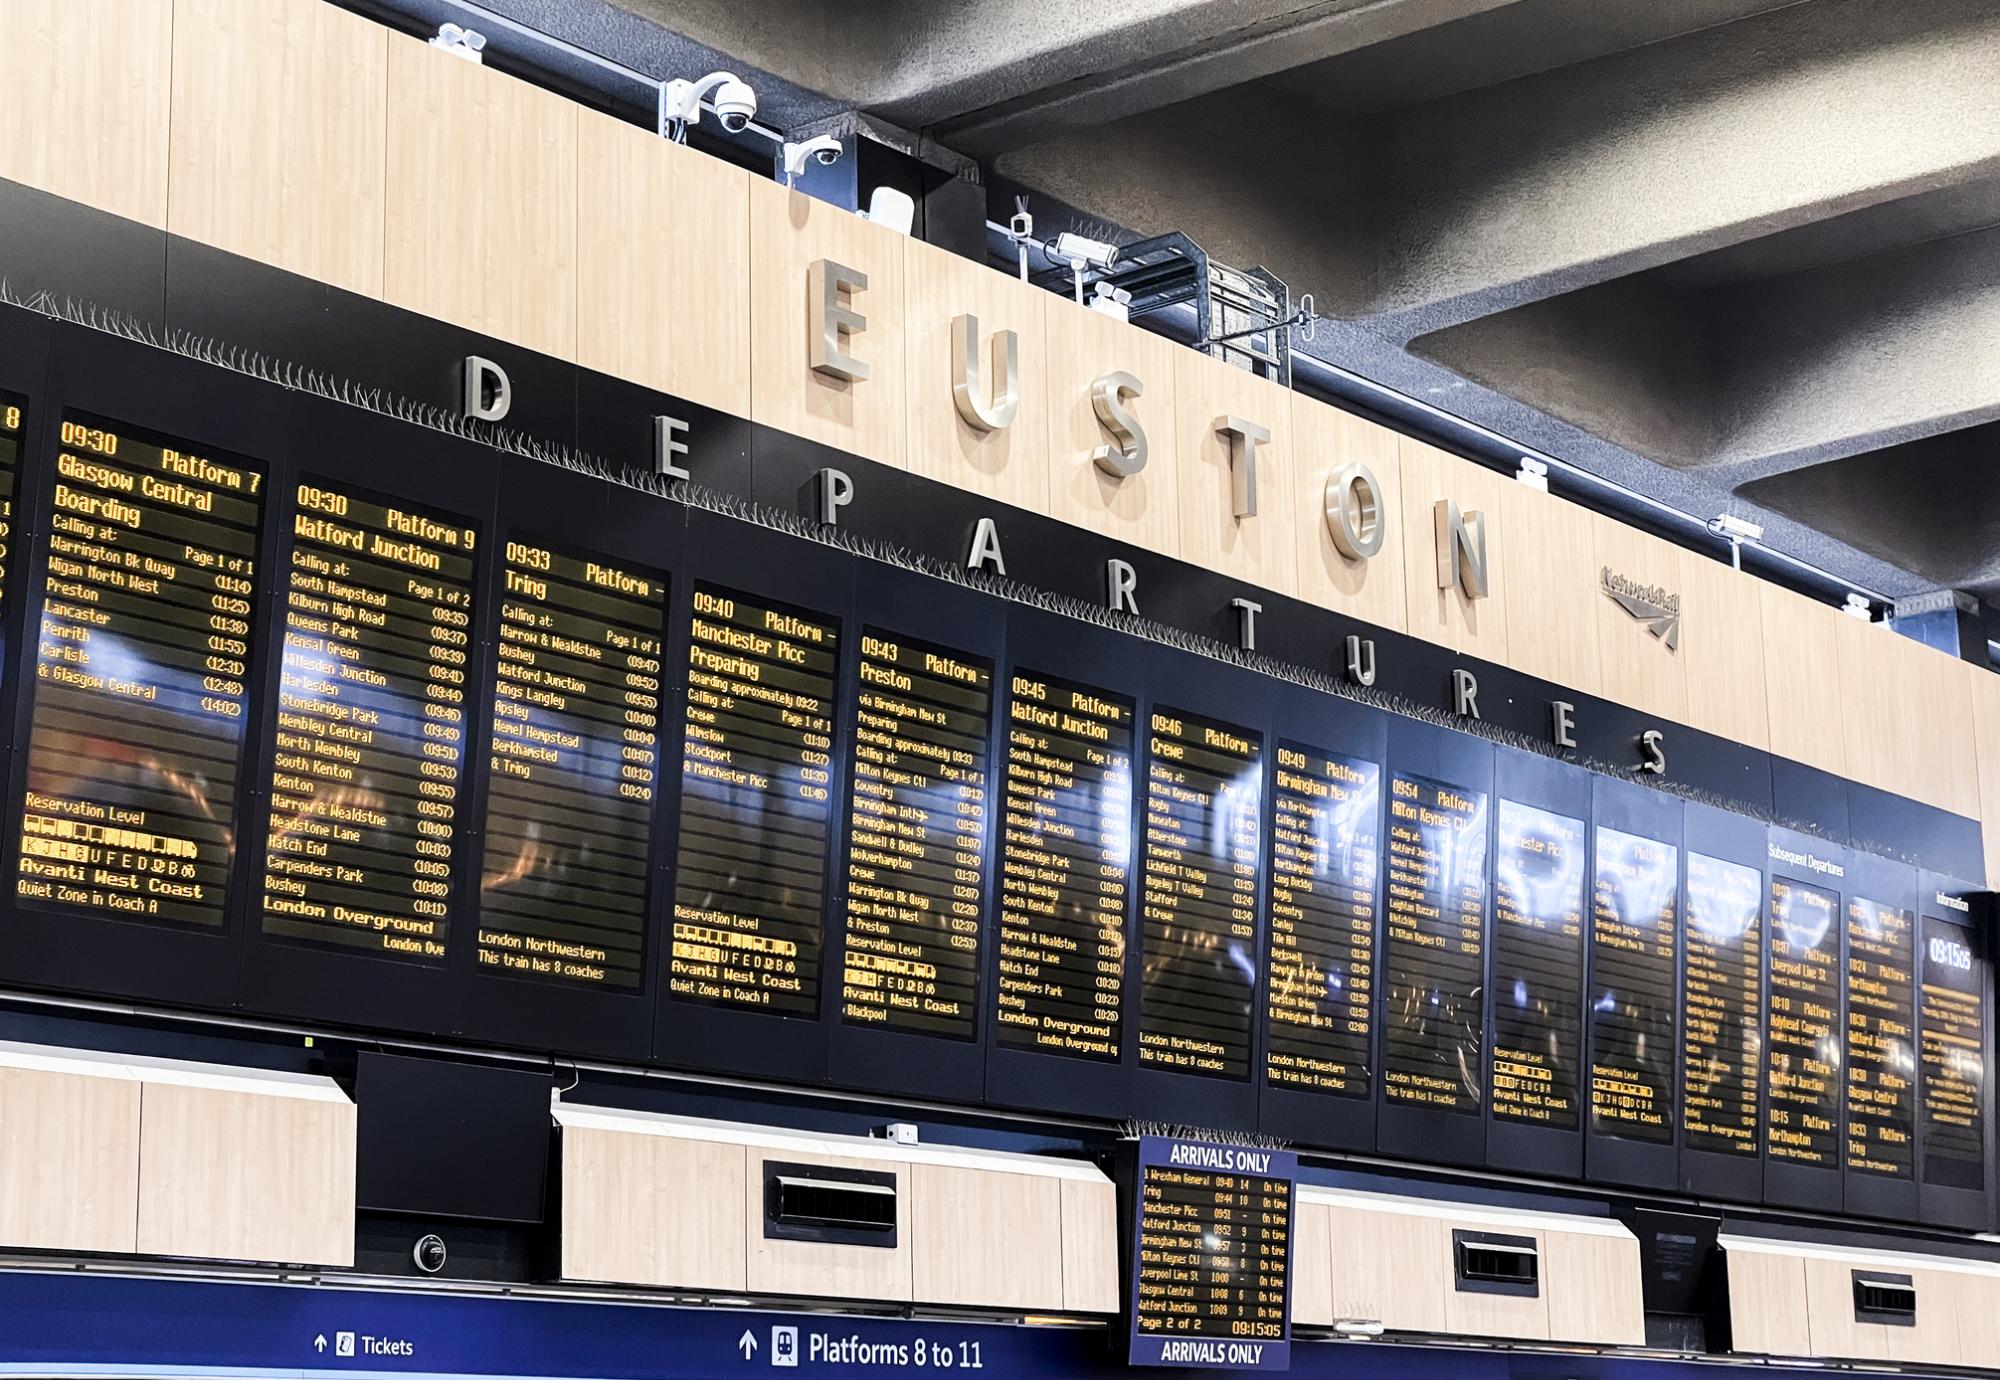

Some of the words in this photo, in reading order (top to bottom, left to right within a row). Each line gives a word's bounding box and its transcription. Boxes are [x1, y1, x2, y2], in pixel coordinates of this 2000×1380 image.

[7, 406, 20, 429] 8
[808, 257, 1489, 601] EUSTON
[61, 422, 117, 455] 09:30
[162, 448, 240, 488] Platform
[249, 472, 261, 492] 7
[58, 454, 133, 491] Glasgow
[142, 476, 212, 511] Central
[55, 485, 140, 529] Boarding
[298, 485, 347, 516] 09:30
[388, 508, 457, 545] Platform
[464, 530, 475, 550] 9
[53, 514, 94, 539] Calling
[99, 527, 117, 541] at:
[185, 546, 214, 567] Page
[218, 555, 224, 567] 1
[228, 557, 242, 571] of
[248, 562, 253, 575] 1
[295, 514, 364, 550] Watford
[371, 535, 440, 570] Junction
[48, 556, 82, 577] Wigan
[88, 565, 124, 586] North
[129, 576, 159, 594] West
[51, 535, 120, 564] Warrington
[126, 553, 140, 568] Bk
[145, 558, 175, 579] Quay
[215, 575, 251, 595] (11:14)
[292, 551, 329, 575] Calling
[334, 563, 350, 576] at:
[408, 580, 433, 598] Page
[437, 588, 442, 600] 1
[447, 590, 460, 604] of
[463, 594, 470, 607] 2
[464, 354, 1669, 776] DEPARTURES
[506, 542, 550, 570] 09:33
[586, 563, 649, 596] Platform
[46, 577, 98, 601] Preston
[290, 573, 323, 592] South
[328, 581, 386, 607] Hampstead
[505, 569, 547, 601] Tring
[45, 598, 110, 625] Lancaster
[289, 591, 328, 613] Kilburn
[332, 601, 355, 620] High
[359, 609, 385, 627] Road
[502, 604, 535, 625] Calling
[540, 615, 553, 627] at:
[694, 592, 734, 619] 09:40
[766, 611, 822, 642] Platform
[43, 621, 90, 642] Penrith
[287, 612, 327, 633] Queens
[332, 622, 358, 640] Park
[500, 624, 537, 643] Harrow
[541, 633, 549, 646] &
[552, 636, 601, 659] Wealdstne
[692, 618, 772, 655] Manchester
[778, 642, 805, 663] Picc
[40, 642, 90, 664] Carlisle
[499, 644, 535, 664] Bushey
[690, 646, 760, 681] Preparing
[862, 636, 897, 662] 09:43
[926, 653, 976, 683] Platform
[38, 664, 49, 677] &
[53, 666, 103, 689] Glasgow
[109, 677, 156, 699] Central
[497, 662, 540, 682] Watford
[544, 672, 586, 694] Junction
[860, 661, 911, 691] Preston
[496, 680, 523, 699] Kings
[527, 688, 565, 710] Langley
[859, 694, 872, 707] via
[874, 697, 917, 718] Birmingham
[919, 707, 935, 721] New
[937, 712, 946, 725] St
[1012, 677, 1046, 700] 09:45
[1072, 692, 1119, 719] Platform
[279, 711, 325, 737] Wembley
[329, 723, 372, 744] Central
[687, 706, 715, 724] Crewe
[1011, 701, 1057, 728] Watford
[1062, 715, 1108, 741] Junction
[1151, 738, 1184, 760] Crewe
[1152, 714, 1182, 736] 09:46
[1205, 728, 1248, 753] Platform
[492, 738, 558, 763] Berkhamsted
[684, 742, 732, 763] Stockport
[1278, 748, 1305, 769] 09:49
[1327, 761, 1365, 785] Platform
[1277, 770, 1328, 797] Birmingham
[1393, 779, 1418, 799] 09:54
[1438, 791, 1474, 814] Platform
[26, 792, 104, 819] Reservation
[110, 804, 144, 825] Level
[1392, 800, 1416, 819] Milton
[1768, 843, 1807, 867] Subsequent
[1808, 854, 1844, 877] Departures
[20, 857, 85, 881] Avanti
[94, 867, 140, 889] West
[149, 877, 203, 899] Coast
[18, 879, 51, 898] Quiet
[58, 885, 88, 903] Zone
[93, 888, 103, 905] in
[108, 893, 144, 912] Coach
[150, 900, 157, 914] A
[1936, 891, 1969, 912] Information
[264, 895, 325, 918] London
[333, 906, 434, 935] Overground
[478, 930, 521, 948] London
[526, 937, 606, 961] Northwestern
[478, 949, 499, 964] This
[503, 953, 529, 969] train
[532, 957, 550, 972] has
[554, 961, 560, 973] 8
[564, 964, 604, 979] coaches
[671, 960, 718, 978] Avanti
[724, 968, 756, 984] West
[762, 974, 801, 990] Coast
[843, 986, 884, 1003] Avanti
[890, 992, 919, 1008] West
[925, 999, 959, 1014] Coast
[998, 1009, 1038, 1026] London
[1043, 1017, 1110, 1037] Overground
[1139, 1032, 1168, 1047] London
[1171, 1036, 1224, 1055] Northwestern
[1524, 1093, 1541, 1105] West
[1545, 1098, 1567, 1109] Coast
[1170, 1144, 1233, 1170] ARRIVALS
[1237, 1151, 1271, 1173] ONLY
[1184, 1173, 1209, 1186] General
[1167, 1285, 1194, 1297] Central
[1137, 1315, 1162, 1330] Page
[1166, 1317, 1174, 1328] 2
[1178, 1318, 1190, 1330] of
[1194, 1318, 1202, 1330] 2
[1232, 1320, 1281, 1337] 09:15:05
[361, 1336, 413, 1355] Tickets
[810, 1333, 909, 1365] Platforms
[914, 1338, 926, 1366] 8
[932, 1342, 953, 1368] to
[959, 1341, 983, 1368] 11
[1161, 1341, 1225, 1363] ARRIVALS
[1228, 1344, 1263, 1364] ONLY
